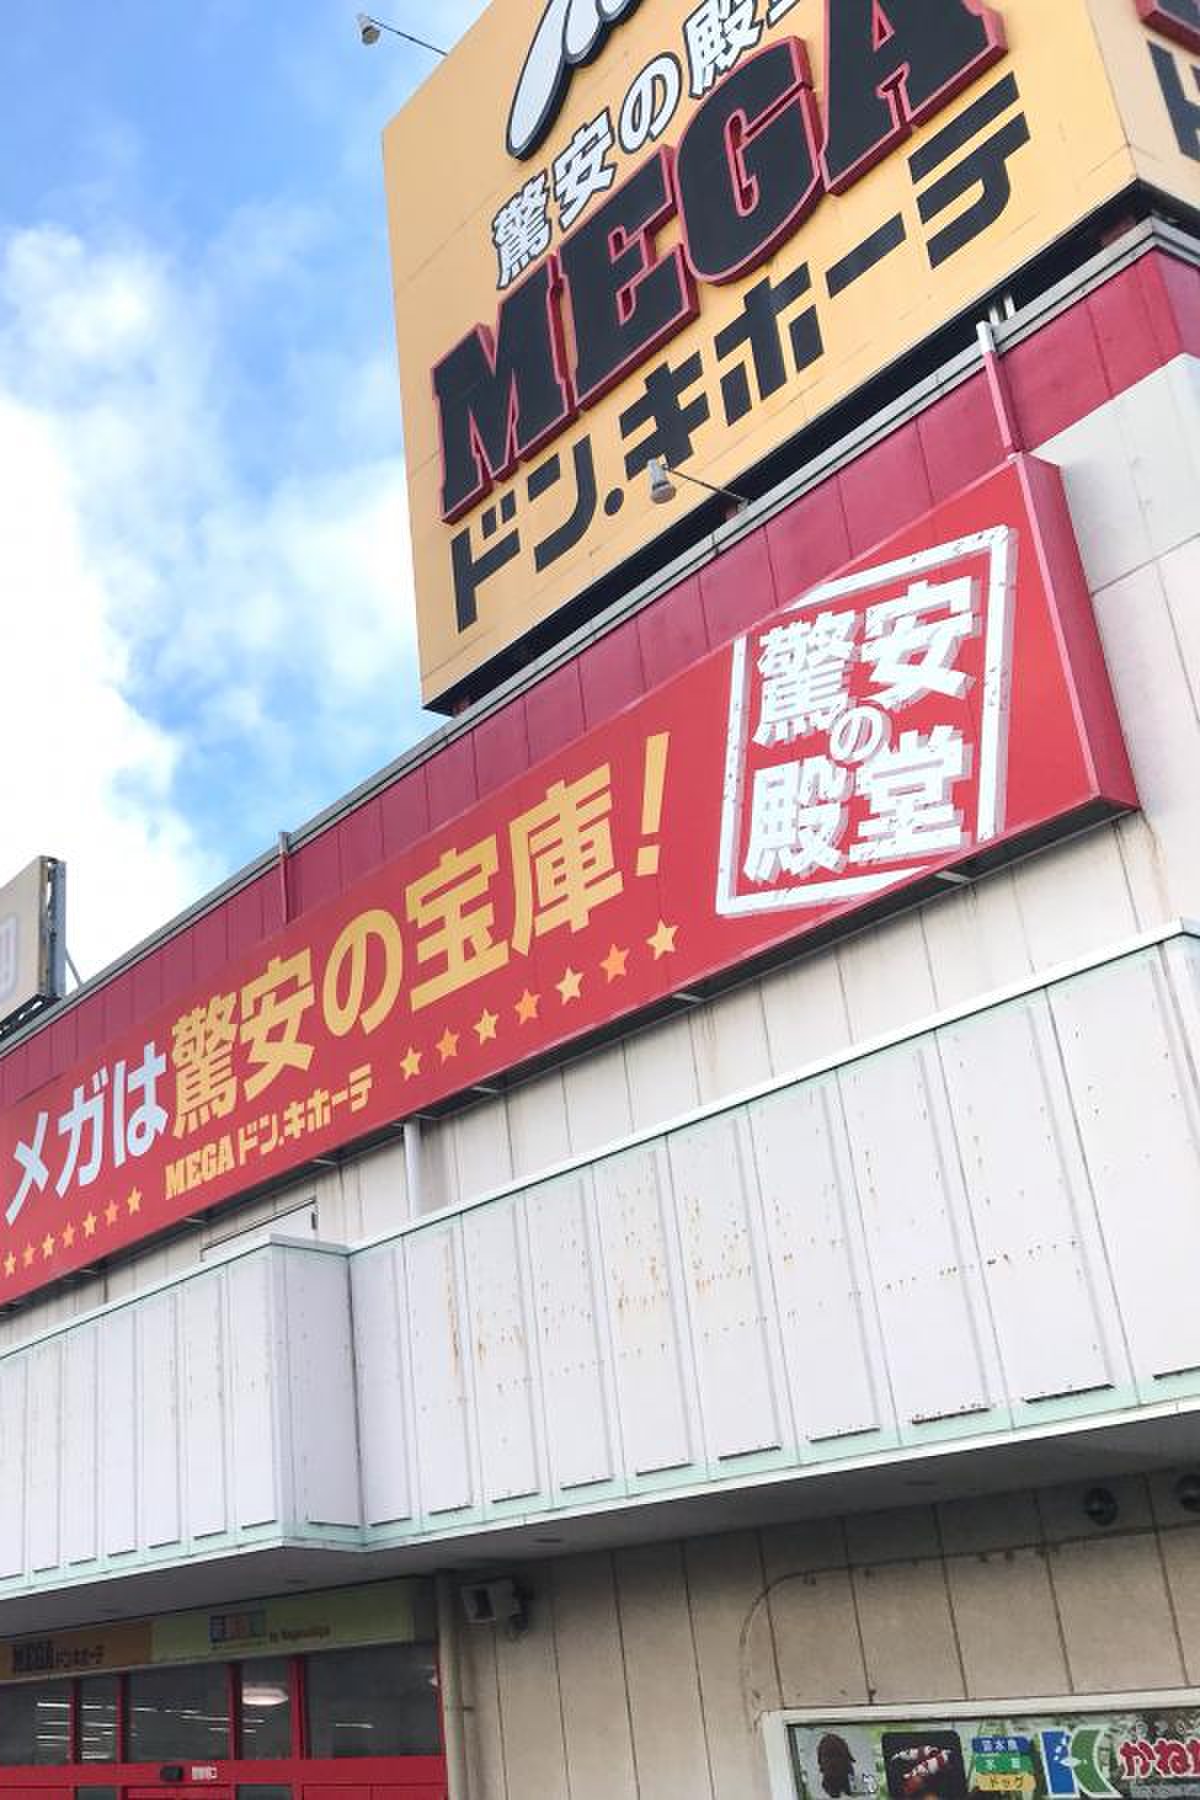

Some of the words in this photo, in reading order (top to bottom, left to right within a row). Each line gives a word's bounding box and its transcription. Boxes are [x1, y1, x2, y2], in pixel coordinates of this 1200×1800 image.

[494, 0, 800, 290] 驚安の殿
[430, 0, 1008, 523] MEGA
[829, 700, 891, 763] の
[165, 1135, 235, 1200] MEGA
